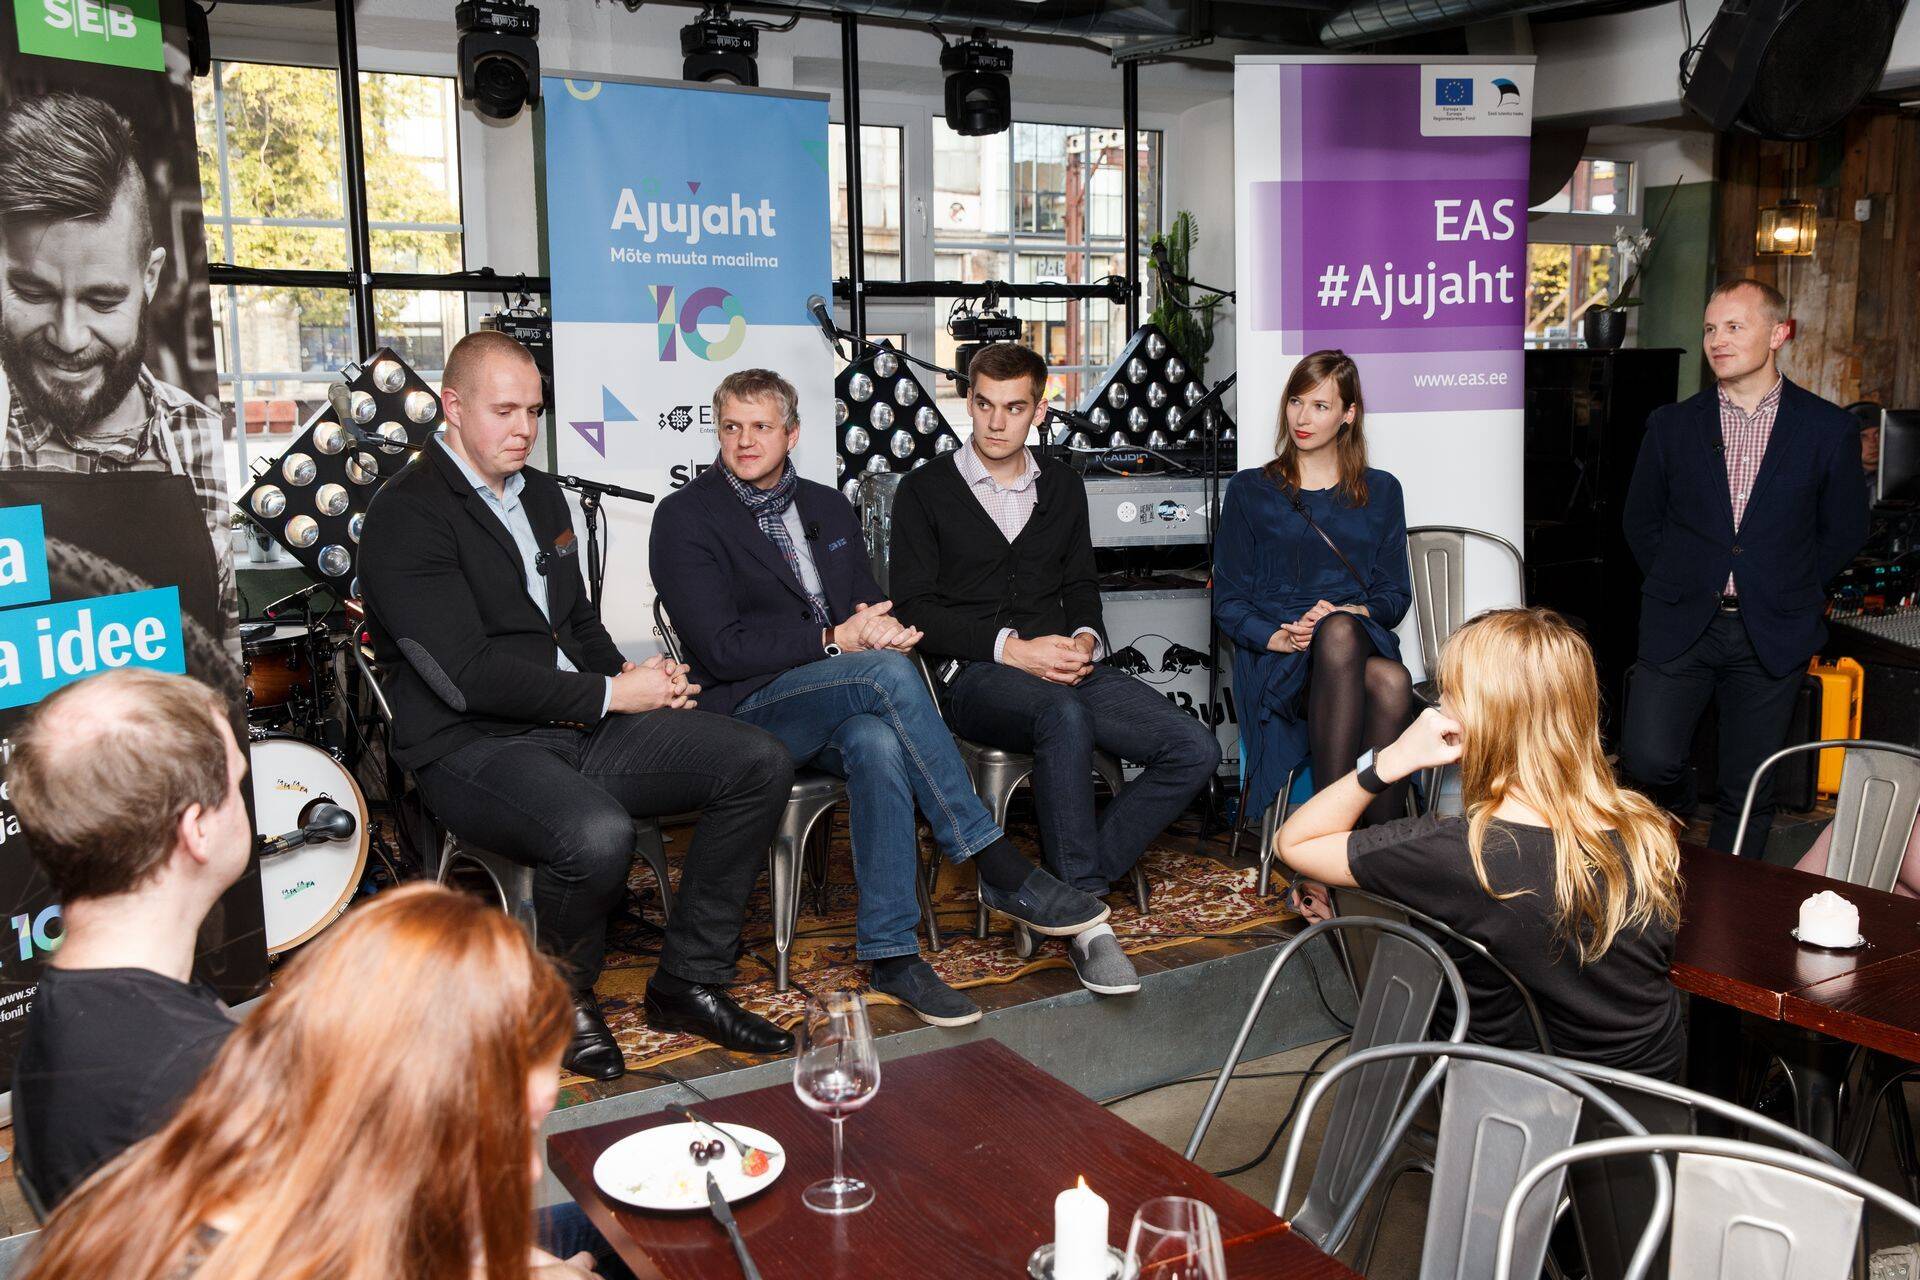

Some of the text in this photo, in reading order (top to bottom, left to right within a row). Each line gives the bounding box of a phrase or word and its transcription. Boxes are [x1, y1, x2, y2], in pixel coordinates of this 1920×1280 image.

[610, 188, 777, 245] Ajujaht
[1434, 198, 1515, 241] EAS
[610, 247, 778, 268] Mõte muuta maailma
[1317, 260, 1515, 321] #Ajujaht
[648, 285, 746, 361] 10
[1414, 372, 1508, 387] www.eas.ee
[36, 608, 167, 680] idee
